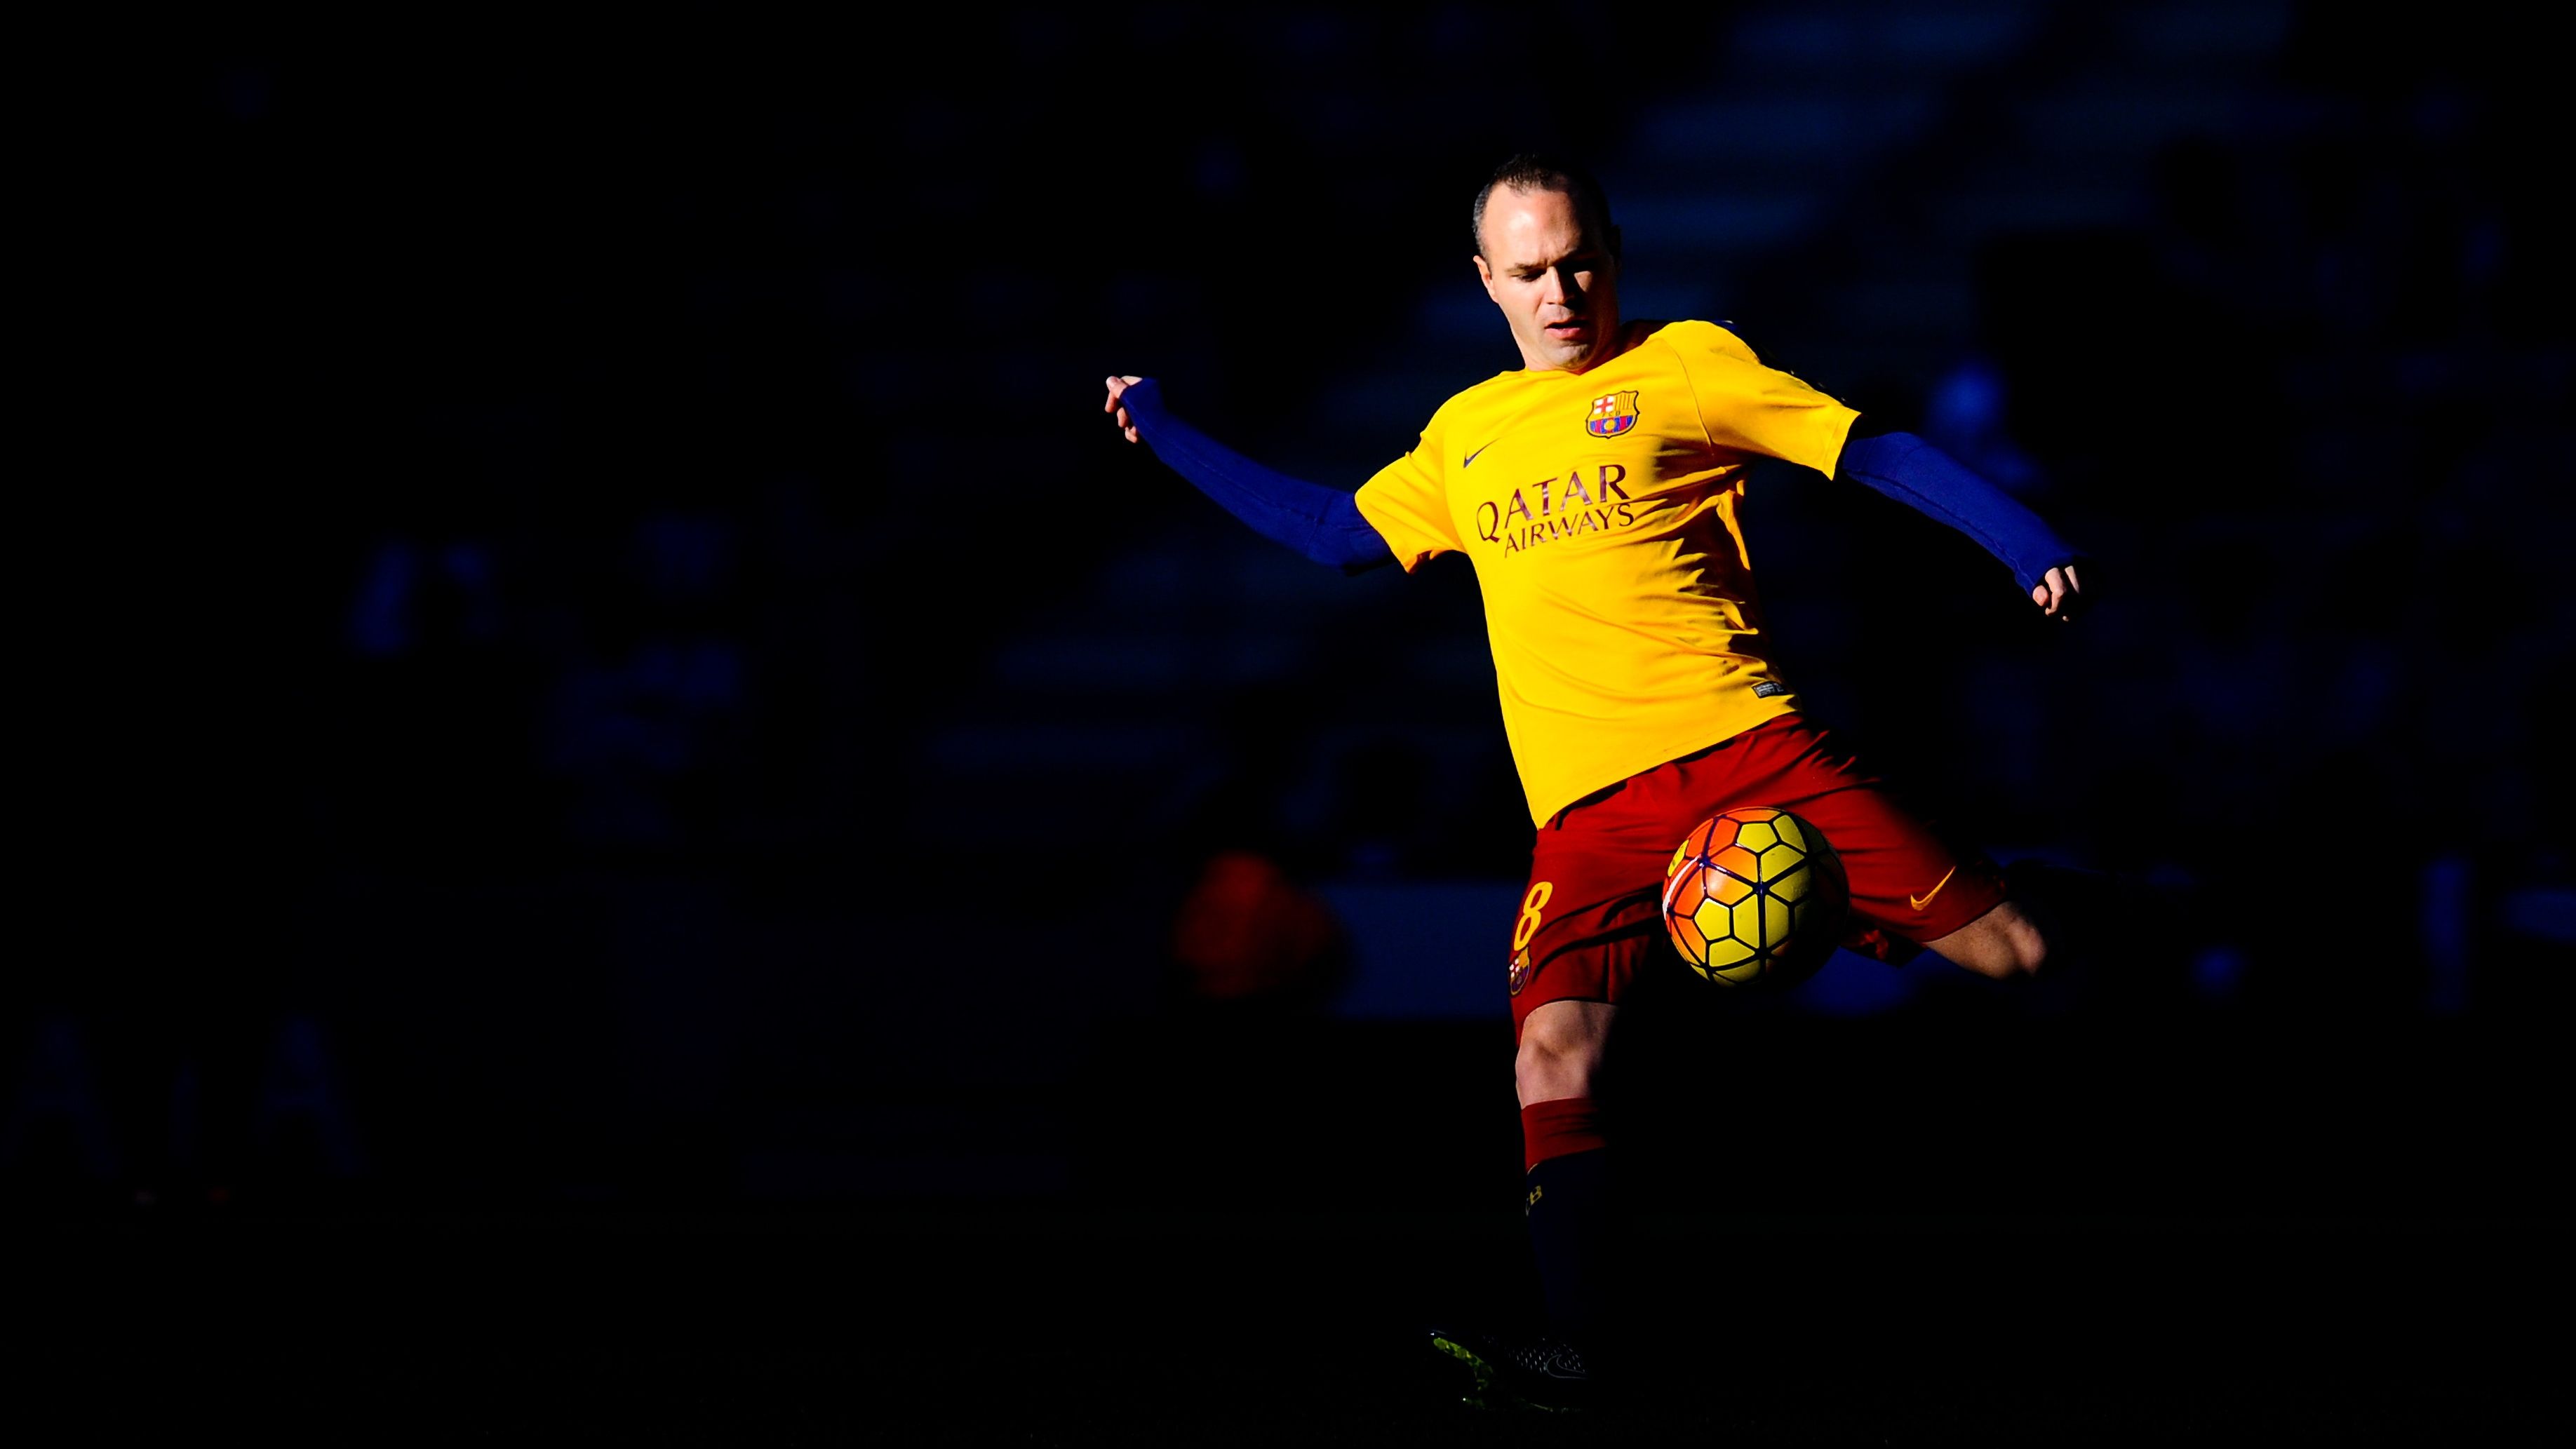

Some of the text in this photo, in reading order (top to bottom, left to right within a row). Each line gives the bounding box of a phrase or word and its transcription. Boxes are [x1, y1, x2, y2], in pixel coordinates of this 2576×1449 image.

[1476, 464, 1631, 543] QATAR
[1504, 502, 1635, 558] AIRWAYS
[1513, 881, 1553, 951] 8
